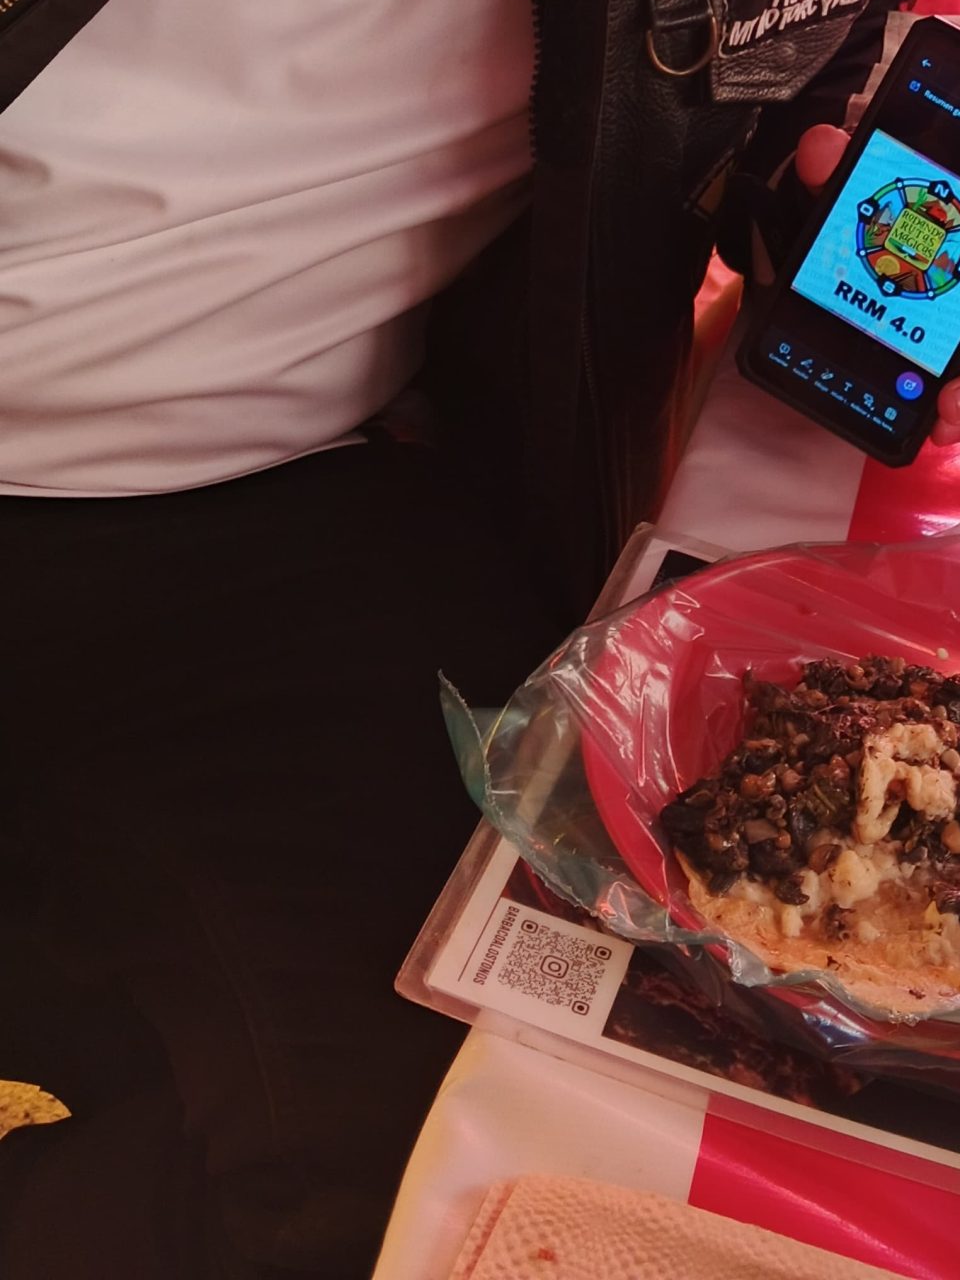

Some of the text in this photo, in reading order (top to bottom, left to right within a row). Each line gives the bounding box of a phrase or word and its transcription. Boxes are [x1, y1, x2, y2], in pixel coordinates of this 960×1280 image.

[923, 89, 954, 113] Resumen
[934, 183, 950, 198] N
[833, 280, 926, 344] RRM 4.0
[473, 906, 520, 986] BARBACOALOSTONOS
